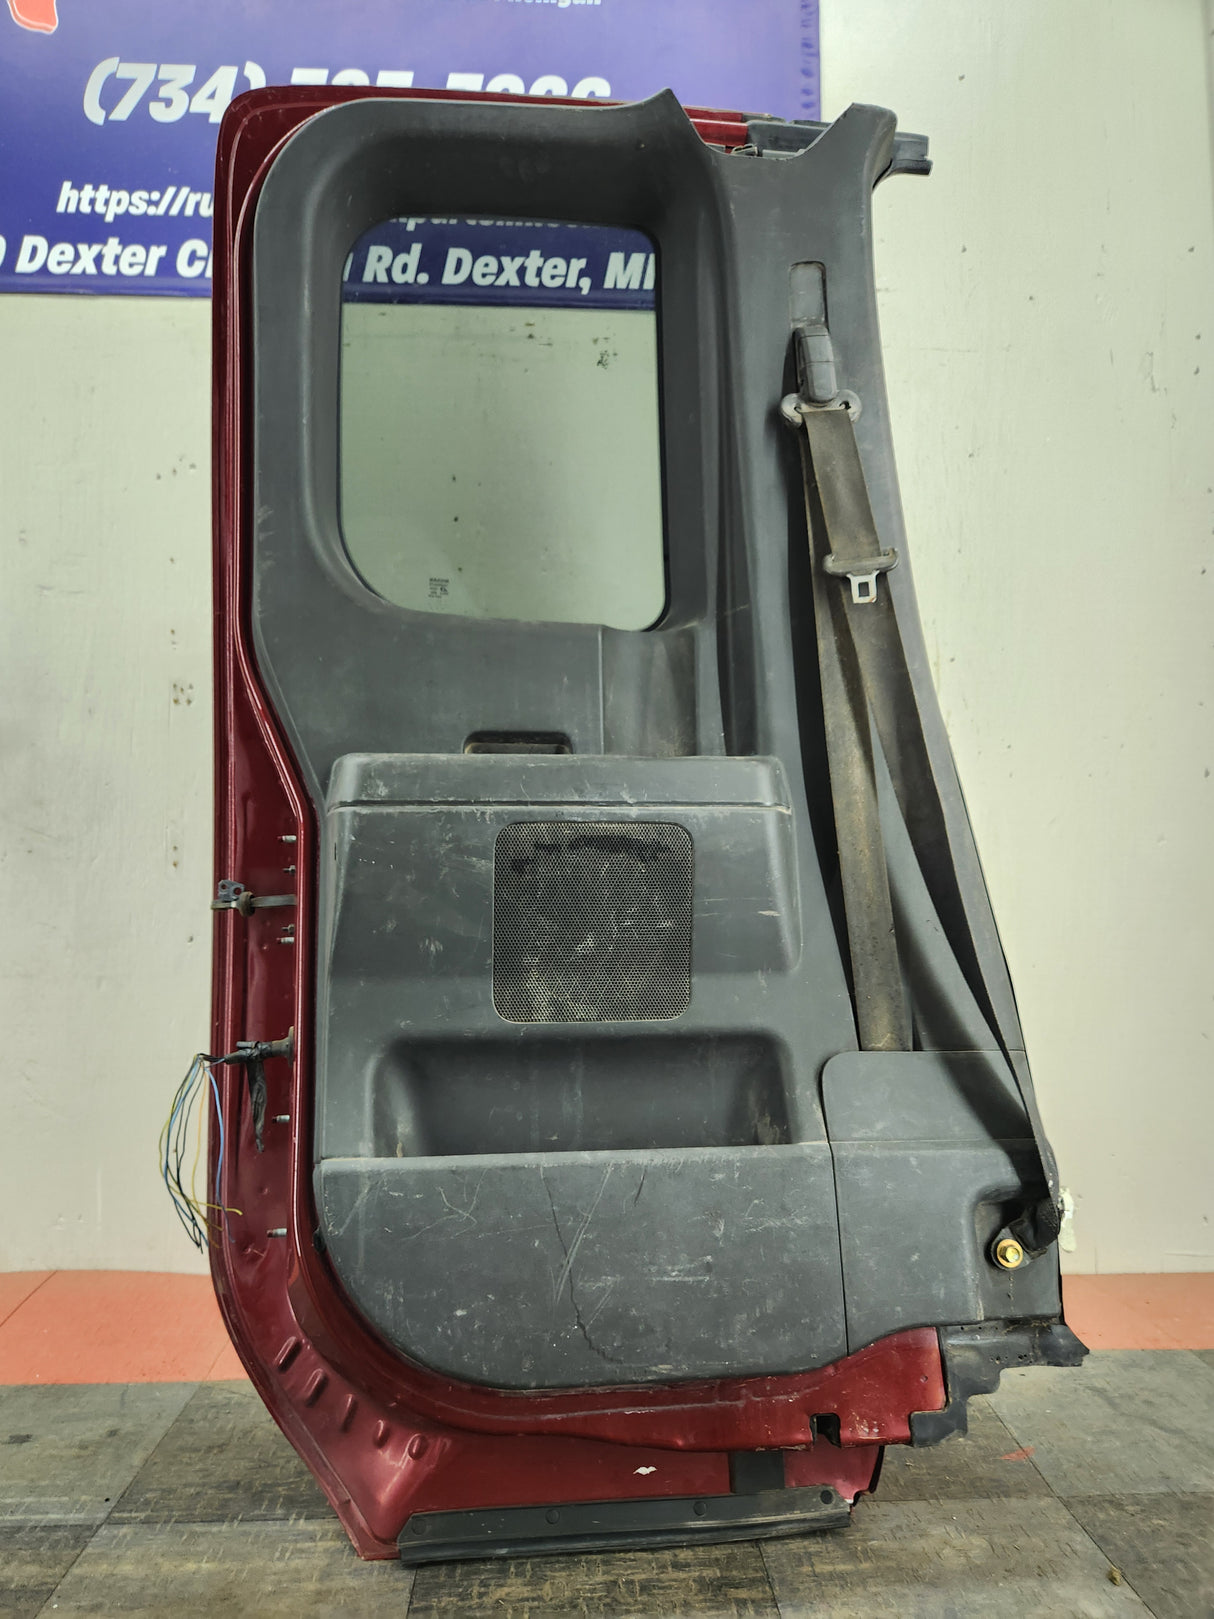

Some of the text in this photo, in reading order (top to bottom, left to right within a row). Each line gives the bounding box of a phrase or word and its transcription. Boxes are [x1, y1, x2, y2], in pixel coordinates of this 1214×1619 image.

[15, 234, 166, 276] Dexter
[362, 243, 429, 284] Rd.
[441, 247, 592, 295] Dexter,
[603, 252, 656, 289] MI
